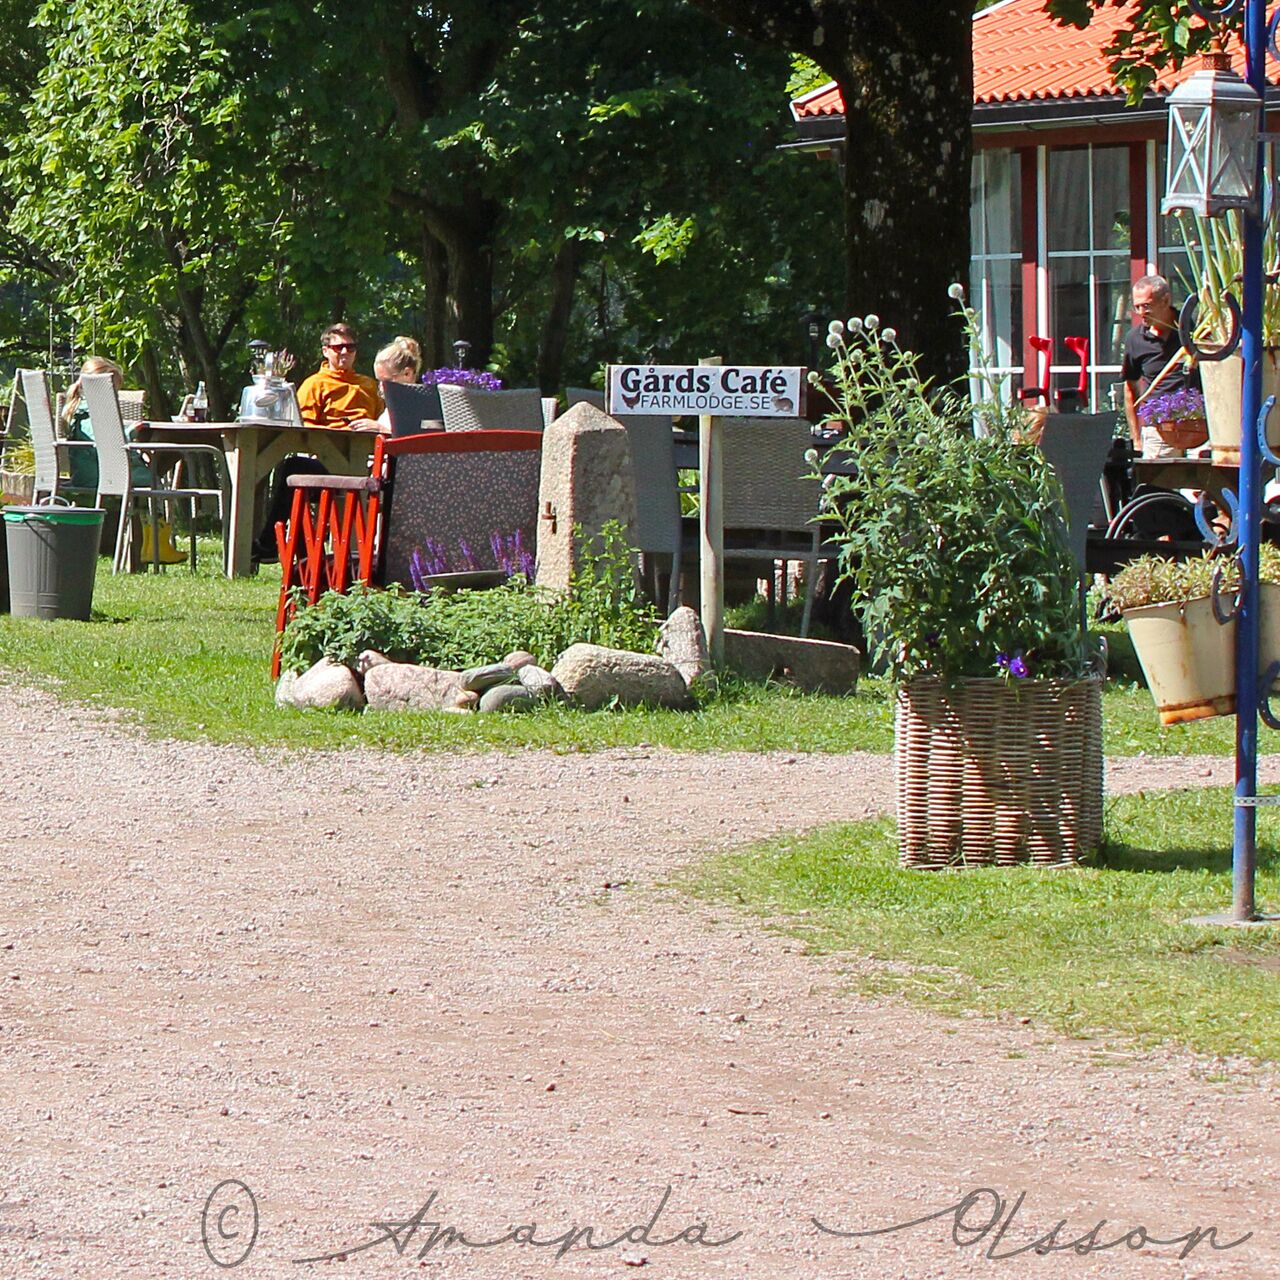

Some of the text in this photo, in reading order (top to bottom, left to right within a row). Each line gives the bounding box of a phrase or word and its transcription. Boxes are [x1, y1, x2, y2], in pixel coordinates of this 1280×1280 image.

[621, 367, 787, 394] Gårds Café
[641, 395, 770, 410] FARMLODGE.SE
